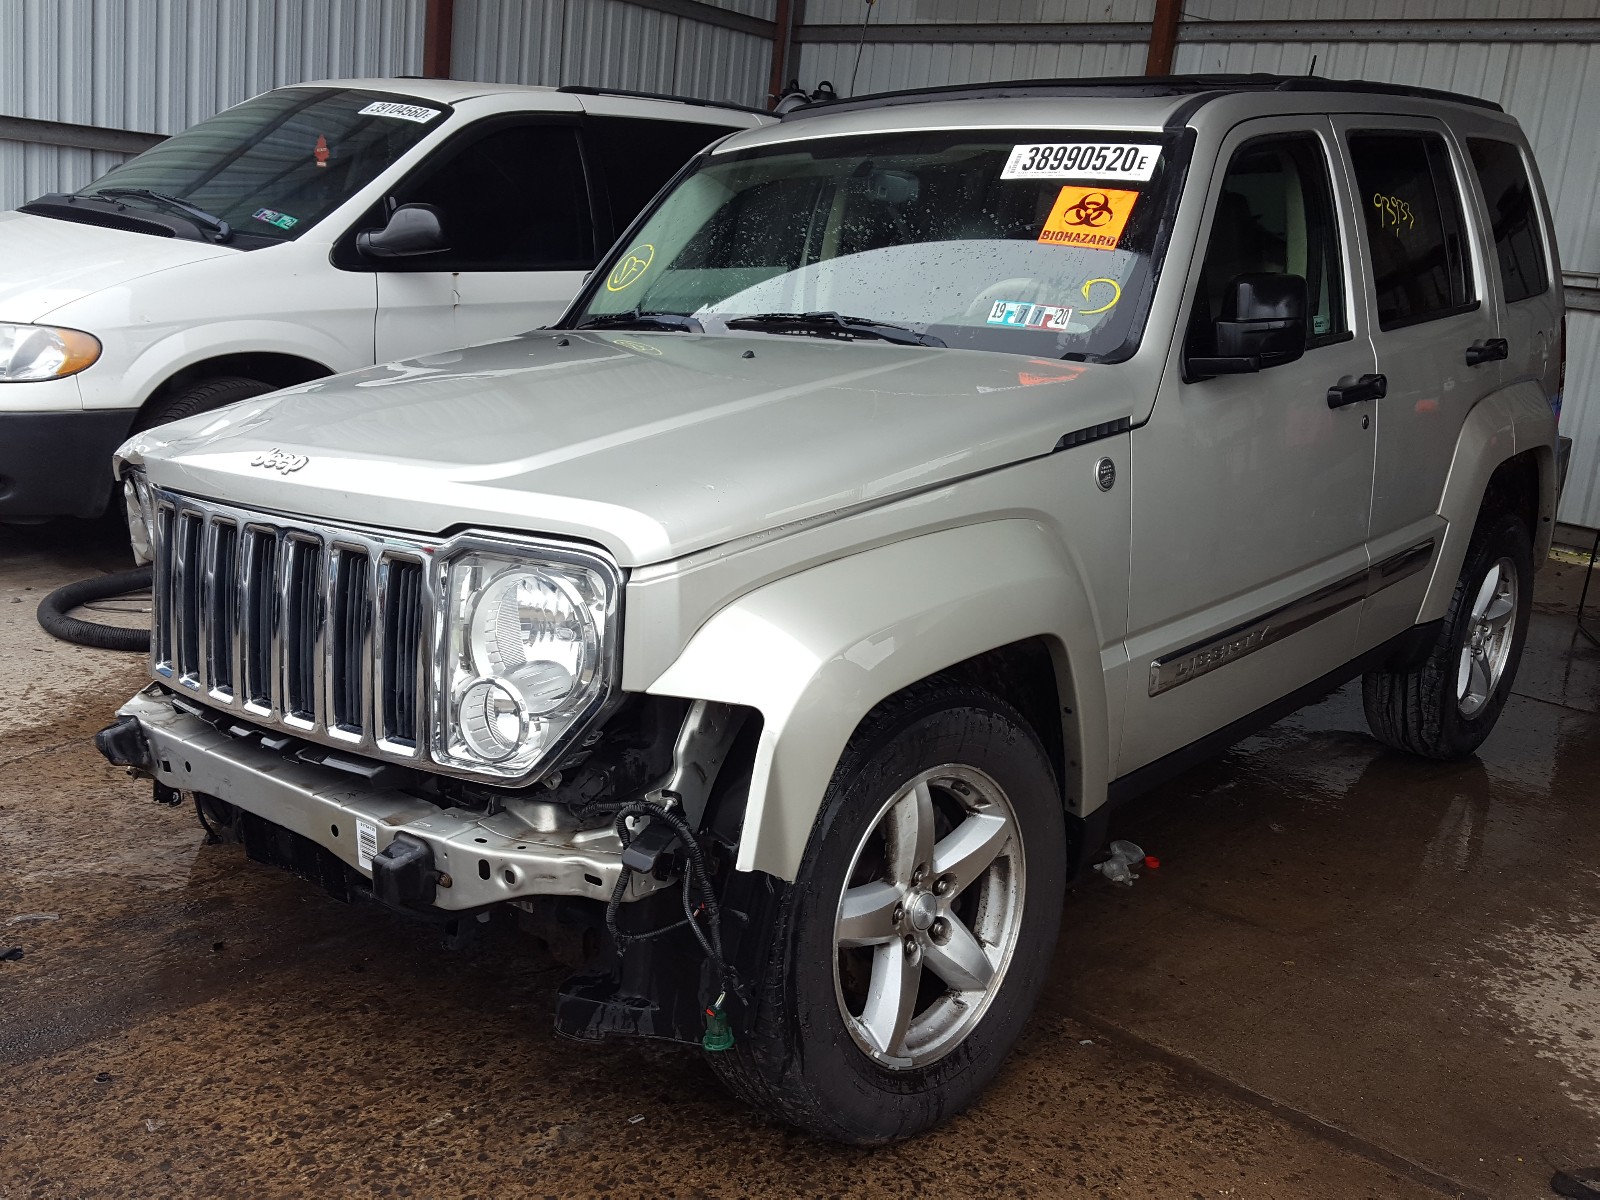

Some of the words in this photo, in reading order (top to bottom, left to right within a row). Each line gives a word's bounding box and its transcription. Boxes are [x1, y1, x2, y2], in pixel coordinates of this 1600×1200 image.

[1041, 230, 1116, 247] BIOHAZARD
[991, 302, 1007, 318] 19
[1054, 308, 1070, 325] 20
[250, 446, 310, 476] Jeep
[1174, 625, 1270, 678] LIBERTY
